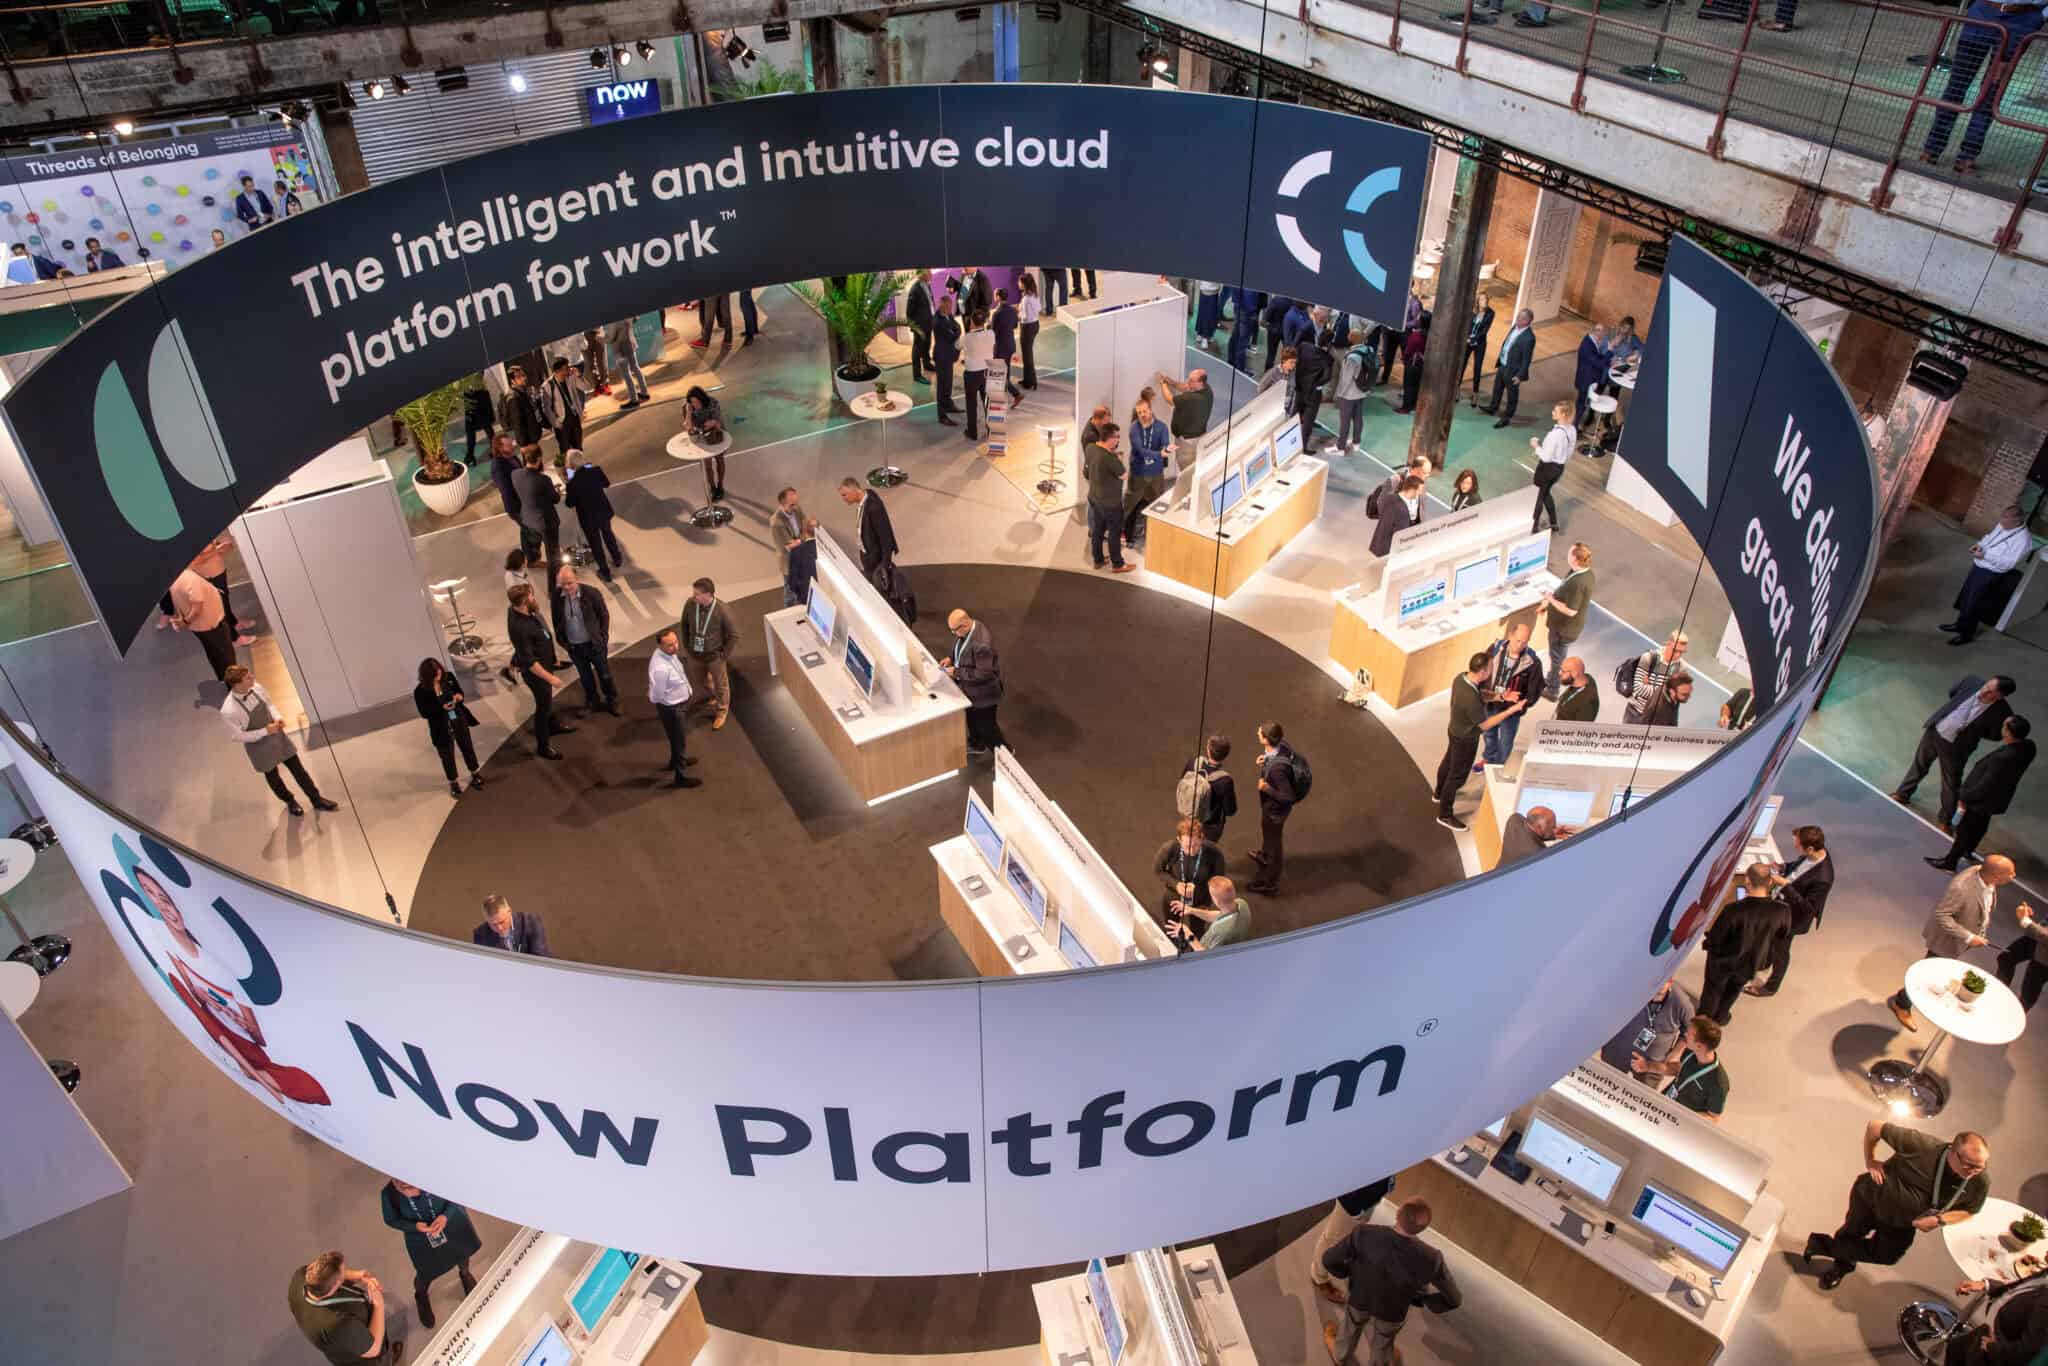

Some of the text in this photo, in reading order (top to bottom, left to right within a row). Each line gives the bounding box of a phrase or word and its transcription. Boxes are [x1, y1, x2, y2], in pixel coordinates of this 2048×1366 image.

[597, 81, 648, 104] now
[26, 141, 199, 176] Threads of Belonging
[290, 126, 1109, 318] The intelligent and intuitive cloud
[320, 282, 517, 404] platform
[526, 256, 591, 302] for
[602, 219, 719, 278] work
[1774, 413, 1840, 668] We delive
[1740, 517, 1796, 658] great
[1541, 728, 1575, 737] Deliver
[1577, 729, 1599, 739] high
[1600, 731, 1662, 743] performance
[1663, 735, 1705, 745] business
[1561, 739, 1601, 749] visibility
[345, 1020, 660, 1167] Now
[714, 1044, 1408, 1186] Platform
[1577, 1076, 1637, 1113] enterprise
[1639, 1110, 1660, 1126] risk
[1578, 1065, 1621, 1091] ecurity
[1622, 1087, 1681, 1127] incidents,
[441, 1328, 465, 1356] with
[465, 1268, 512, 1329] proactive
